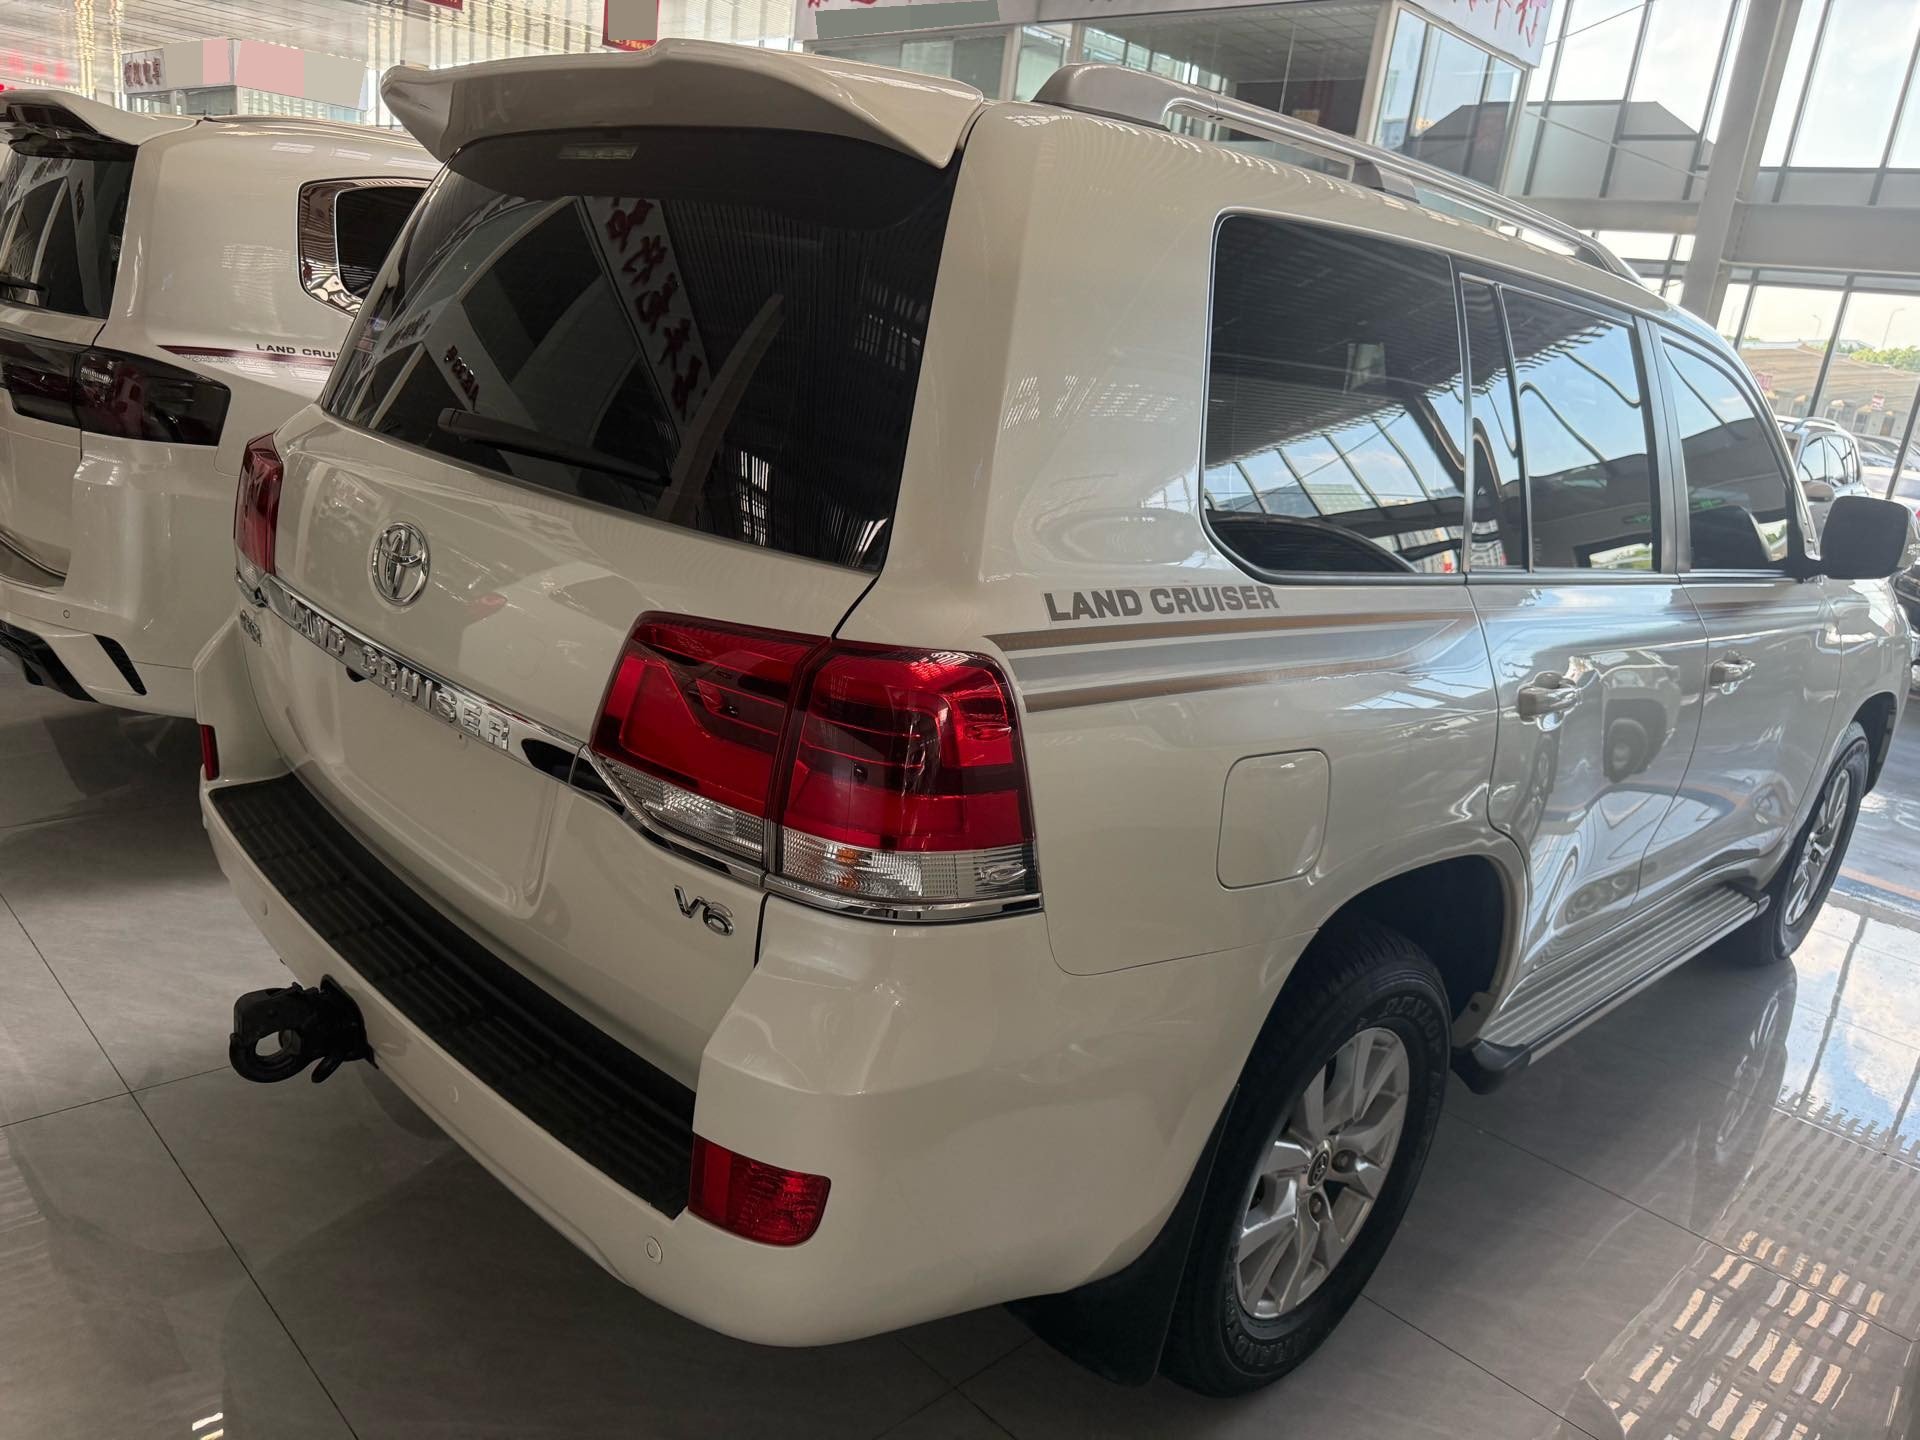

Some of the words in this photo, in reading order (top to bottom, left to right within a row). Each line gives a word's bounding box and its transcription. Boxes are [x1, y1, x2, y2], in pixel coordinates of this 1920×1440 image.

[256, 343, 296, 354] LAND
[302, 348, 341, 358] CRUI
[1043, 590, 1143, 622] LAND
[1150, 585, 1280, 615] CRUISER
[290, 598, 347, 656] LAND
[360, 644, 511, 751] CRUISER
[674, 884, 734, 937] V6
